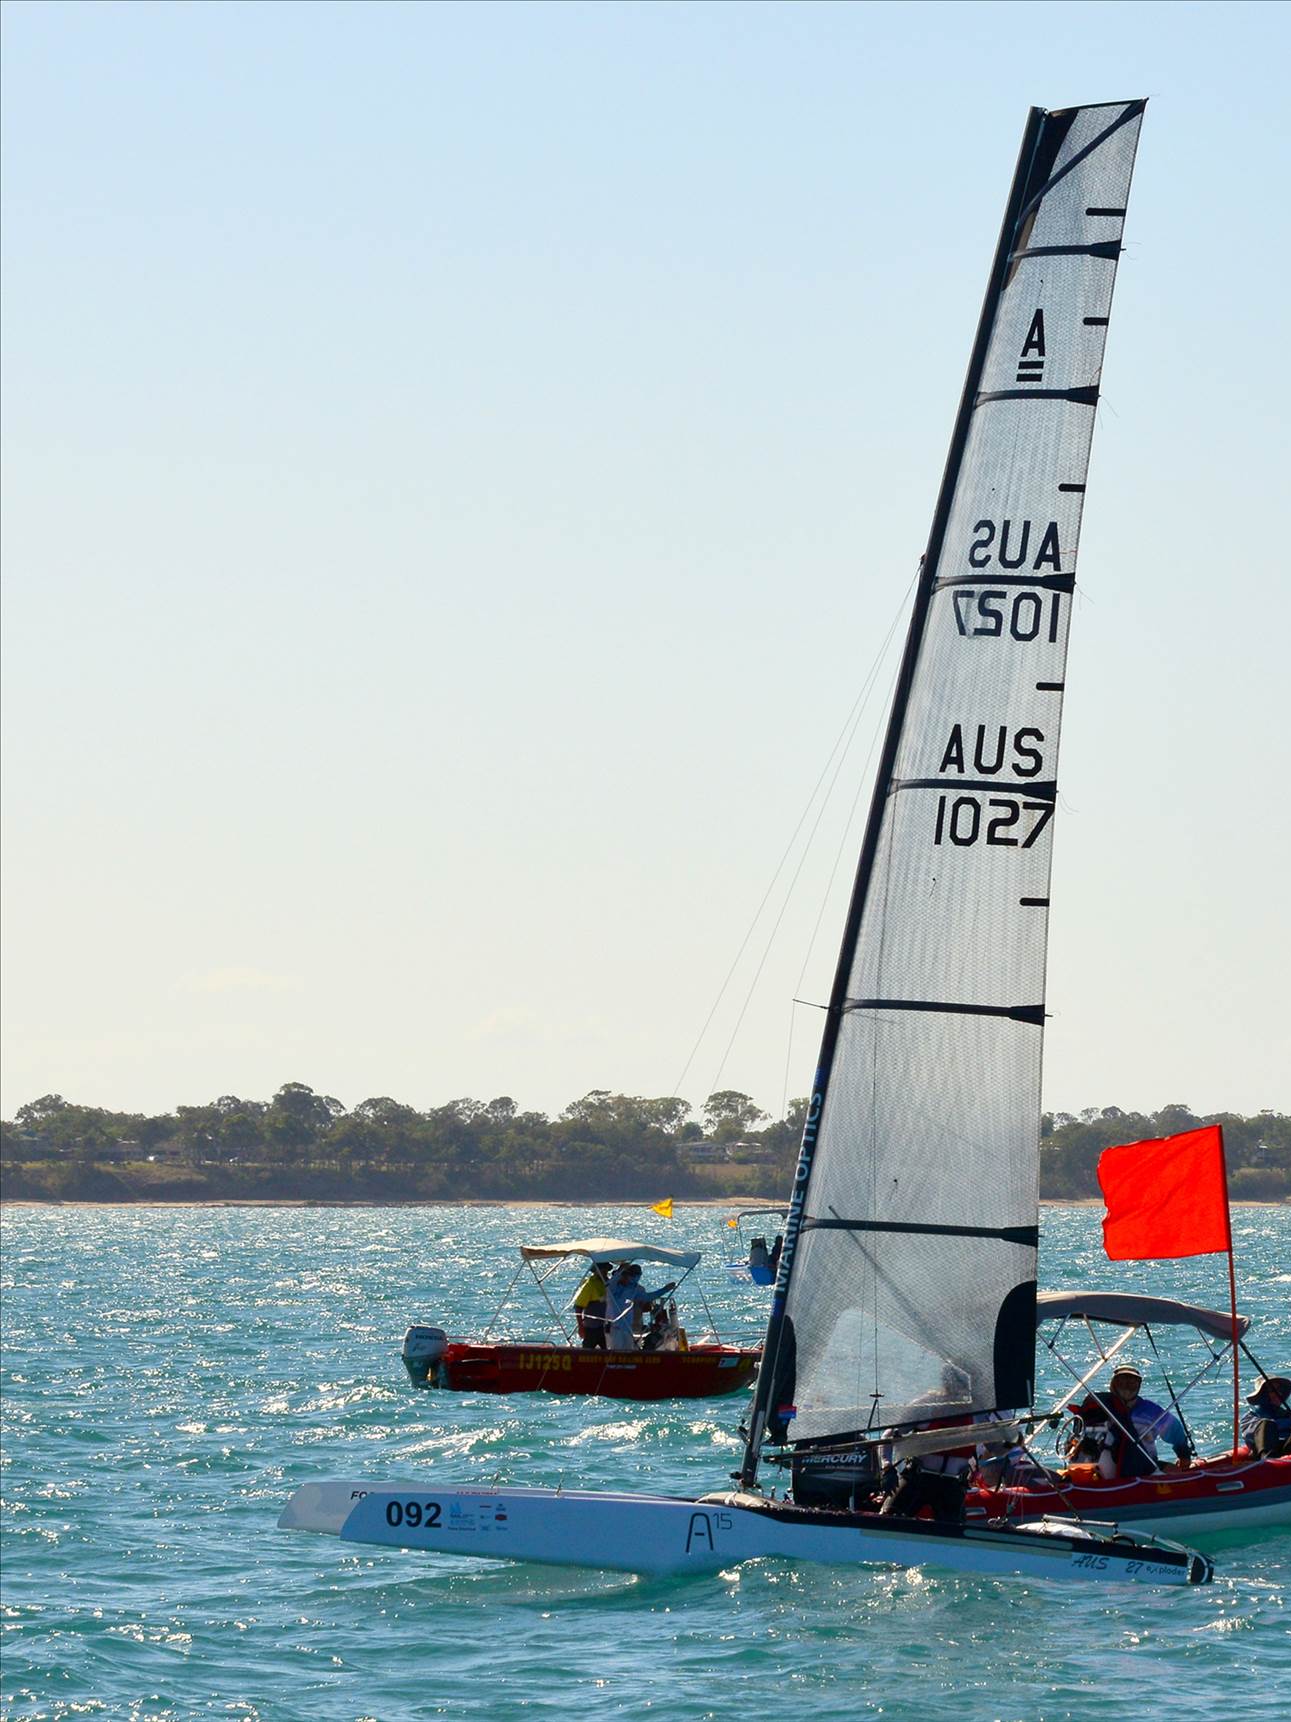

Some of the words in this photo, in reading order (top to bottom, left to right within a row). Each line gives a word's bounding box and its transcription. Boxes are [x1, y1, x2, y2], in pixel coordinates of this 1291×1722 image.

[939, 723, 1045, 778] AUS
[934, 795, 1056, 849] 1027
[775, 1188, 805, 1293] MARINE
[796, 1092, 822, 1182] OPTICS
[801, 1453, 868, 1465] MERCURY
[386, 1501, 442, 1528] 092
[1072, 1554, 1110, 1571] AUS
[1125, 1560, 1144, 1575] 27
